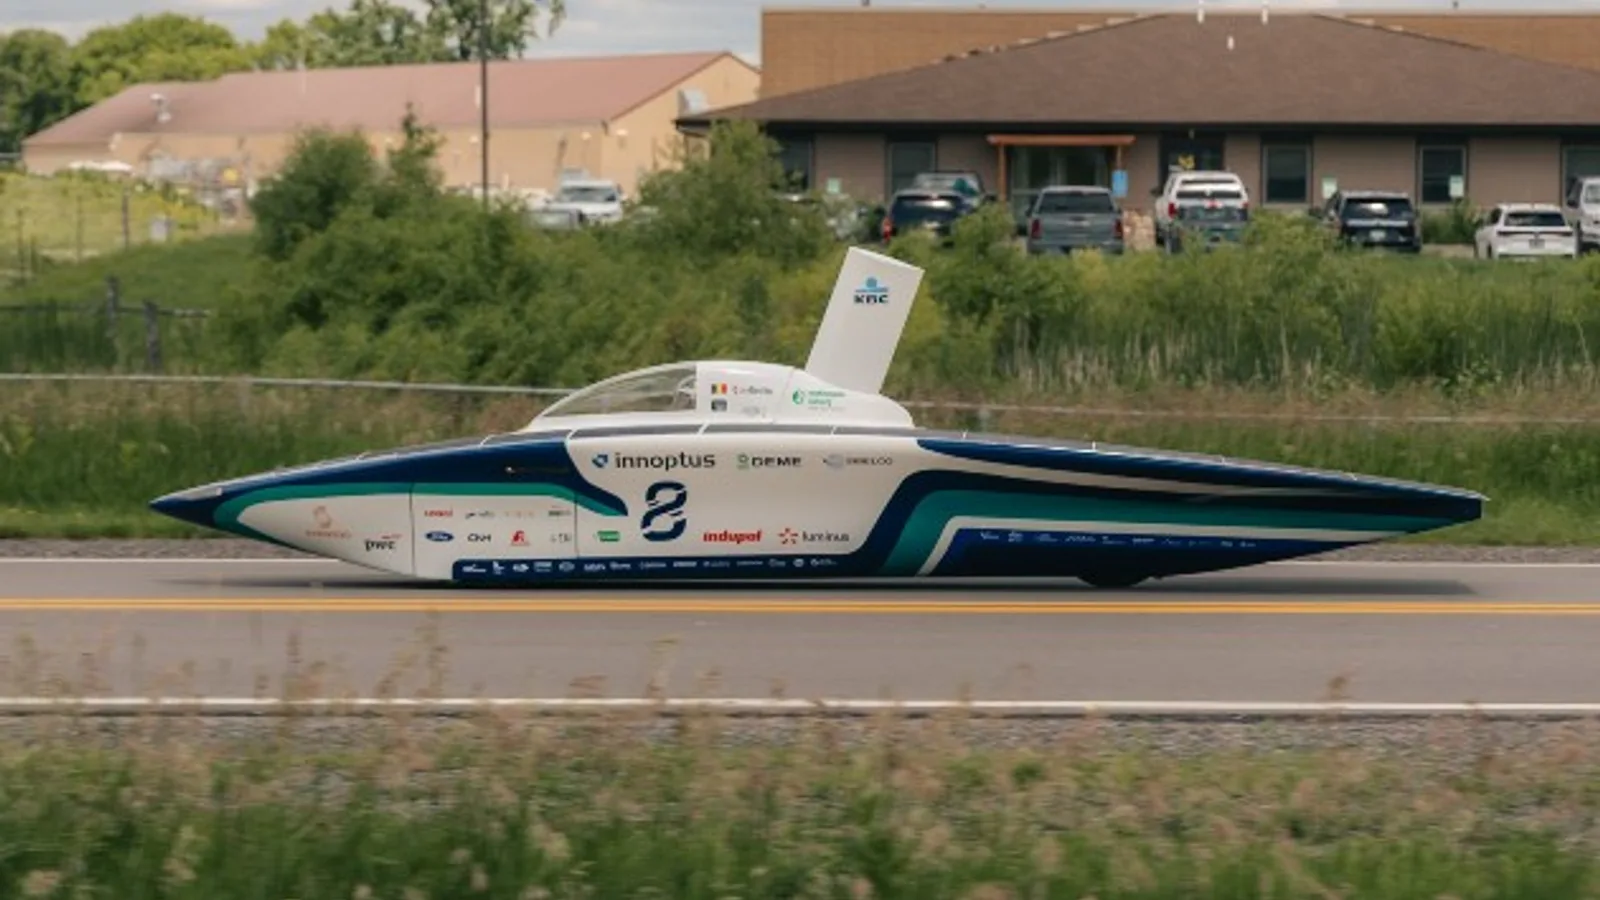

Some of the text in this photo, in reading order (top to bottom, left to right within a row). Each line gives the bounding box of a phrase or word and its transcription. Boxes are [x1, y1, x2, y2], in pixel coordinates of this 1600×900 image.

[614, 452, 716, 472] innoptus
[751, 456, 802, 467] DEME
[640, 481, 689, 542] 8
[702, 530, 762, 544] indupol
[802, 531, 850, 543] luminus
[365, 539, 396, 552] pwc
